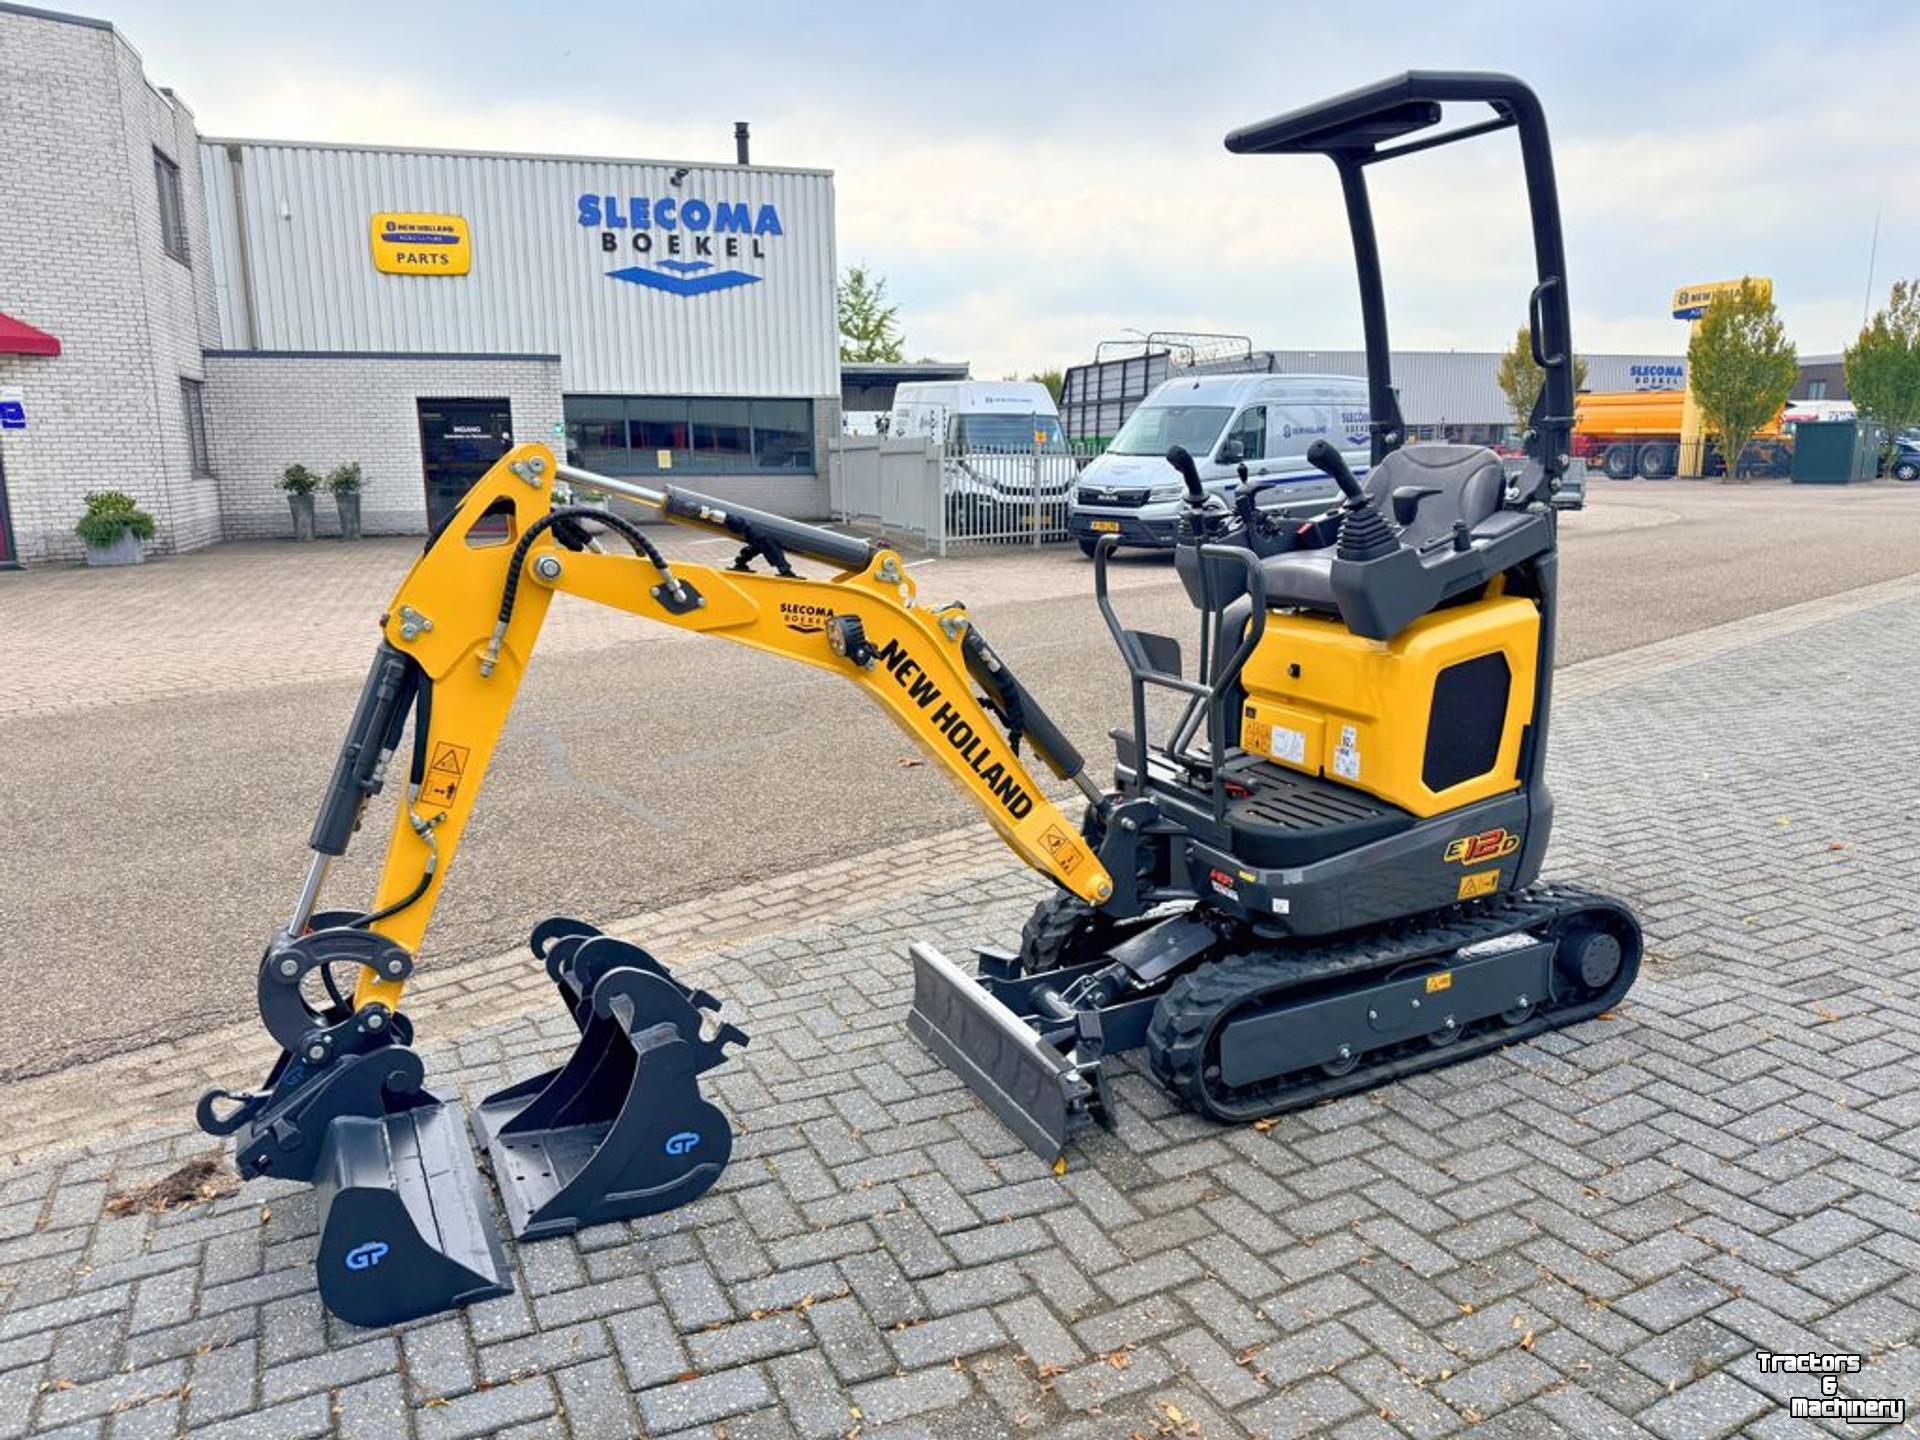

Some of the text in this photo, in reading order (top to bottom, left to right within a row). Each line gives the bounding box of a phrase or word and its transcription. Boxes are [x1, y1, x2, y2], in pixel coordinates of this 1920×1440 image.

[578, 194, 783, 235] SLECOMA
[602, 232, 764, 258] BOEKEL
[396, 252, 449, 265] PARTS
[1691, 292, 1712, 301] NEW
[1630, 366, 1683, 376] SLECOMA
[780, 602, 834, 617] SLECOMA
[879, 639, 1033, 820] NEW HOLLAND
[665, 1132, 700, 1154] GP
[346, 1241, 389, 1270] GP
